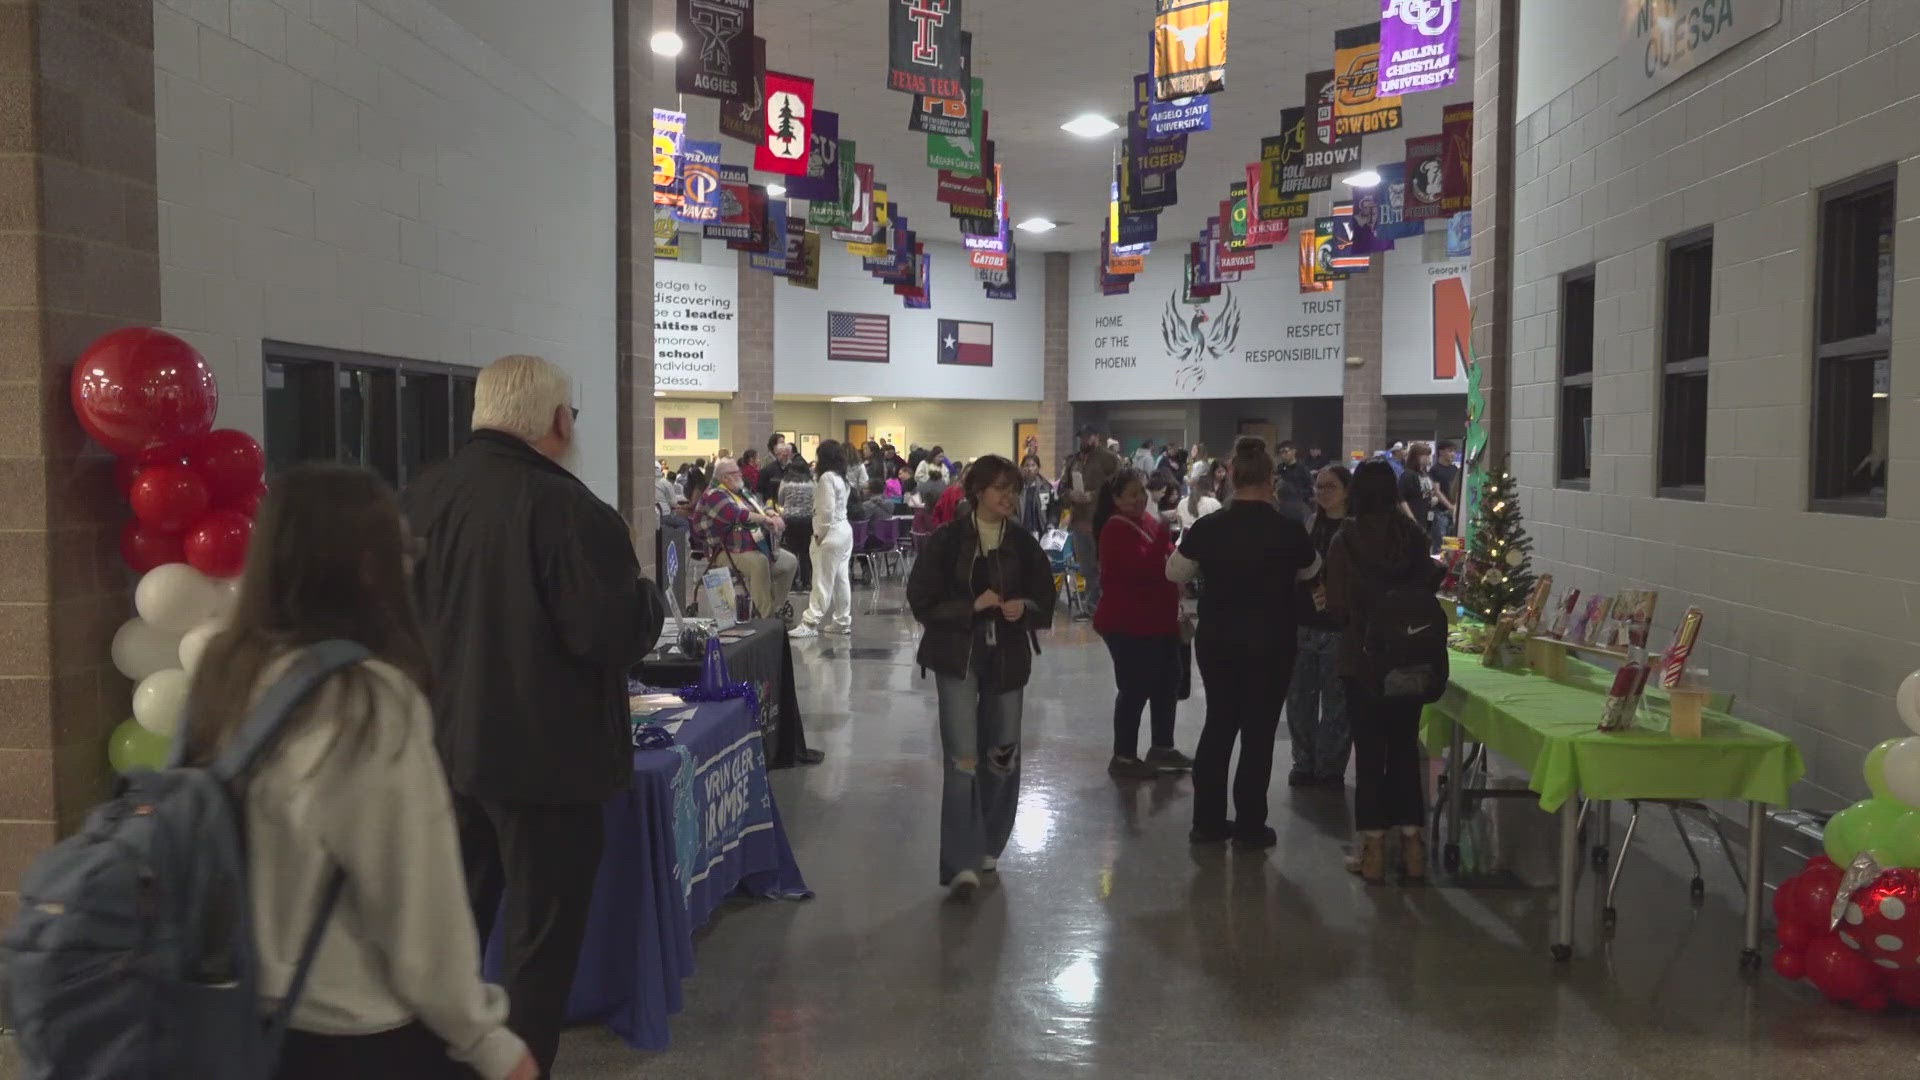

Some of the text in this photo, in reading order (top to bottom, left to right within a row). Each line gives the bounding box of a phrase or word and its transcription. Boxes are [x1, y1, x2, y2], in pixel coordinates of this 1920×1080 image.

[1391, 43, 1444, 63] ABILENE
[1386, 55, 1450, 78] CHRISTIAN
[695, 73, 738, 93] AGGIES
[892, 70, 959, 96] TEXAS TECH
[1381, 68, 1455, 92] UNIVERSITY
[1151, 105, 1208, 121] ANGELO STATE
[1336, 109, 1398, 135] COWBOYS
[929, 154, 980, 171] MEAN GREEN
[1137, 151, 1184, 169] TIGERS
[1306, 146, 1359, 168] BROWN
[1281, 174, 1328, 193] BUFFALOES
[1263, 205, 1304, 218] BEARS
[706, 226, 749, 238] BULLDOGS
[1250, 222, 1284, 235] CORNELL
[965, 238, 1003, 250] WILDCATS
[1221, 256, 1254, 267] HARVARD
[1428, 265, 1459, 276] George
[694, 281, 707, 292] to
[673, 310, 681, 318] a
[685, 309, 733, 320] leader
[1302, 300, 1341, 315] TRUST
[702, 324, 716, 332] as
[1095, 315, 1123, 328] HOME
[1286, 323, 1341, 338] RESPECT
[1095, 336, 1129, 349] OF THE
[658, 349, 704, 360] school
[1245, 347, 1340, 364] RESPONSIBILITY
[1095, 357, 1137, 369] PHOENIX
